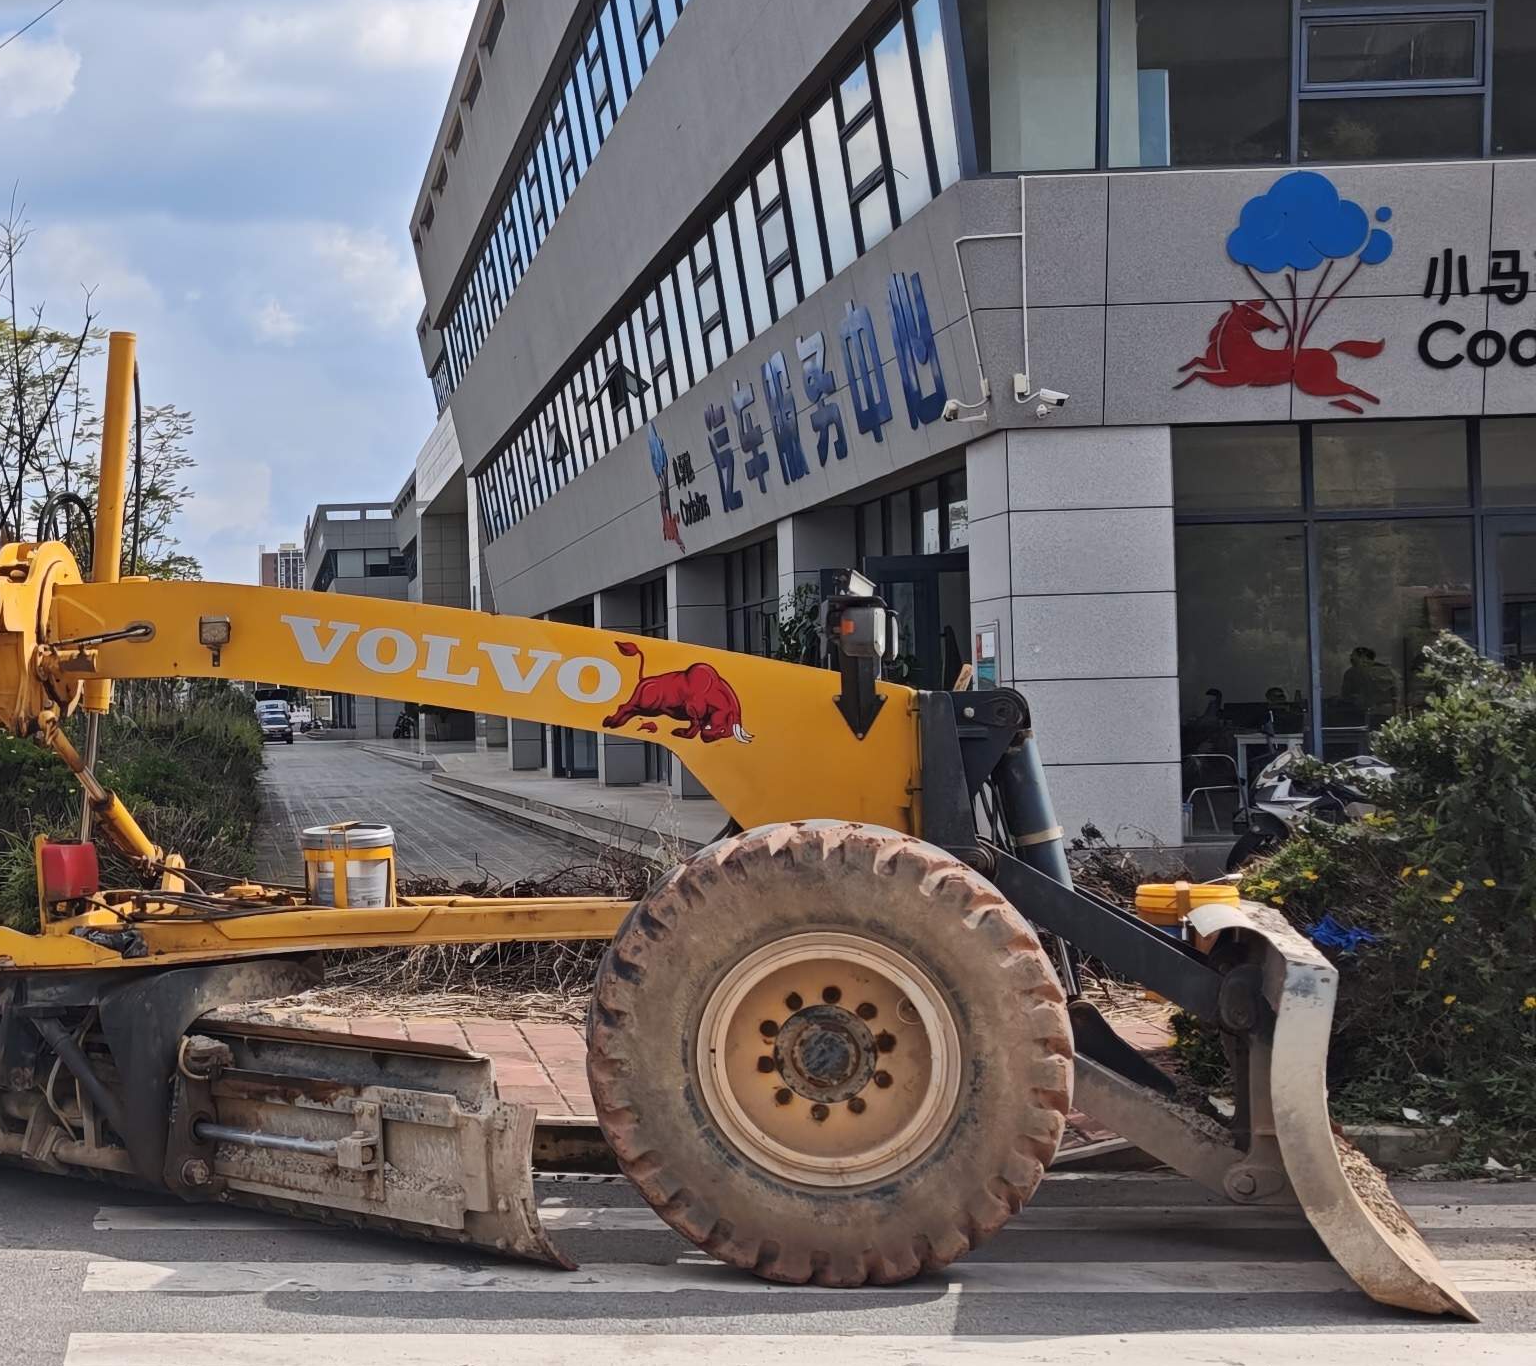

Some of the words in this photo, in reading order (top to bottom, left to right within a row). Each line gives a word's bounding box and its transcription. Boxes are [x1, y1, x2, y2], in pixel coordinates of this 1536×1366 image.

[1423, 248, 1529, 305] 小马
[704, 272, 948, 513] 汽车服务中心
[280, 614, 623, 704] VOLVO
